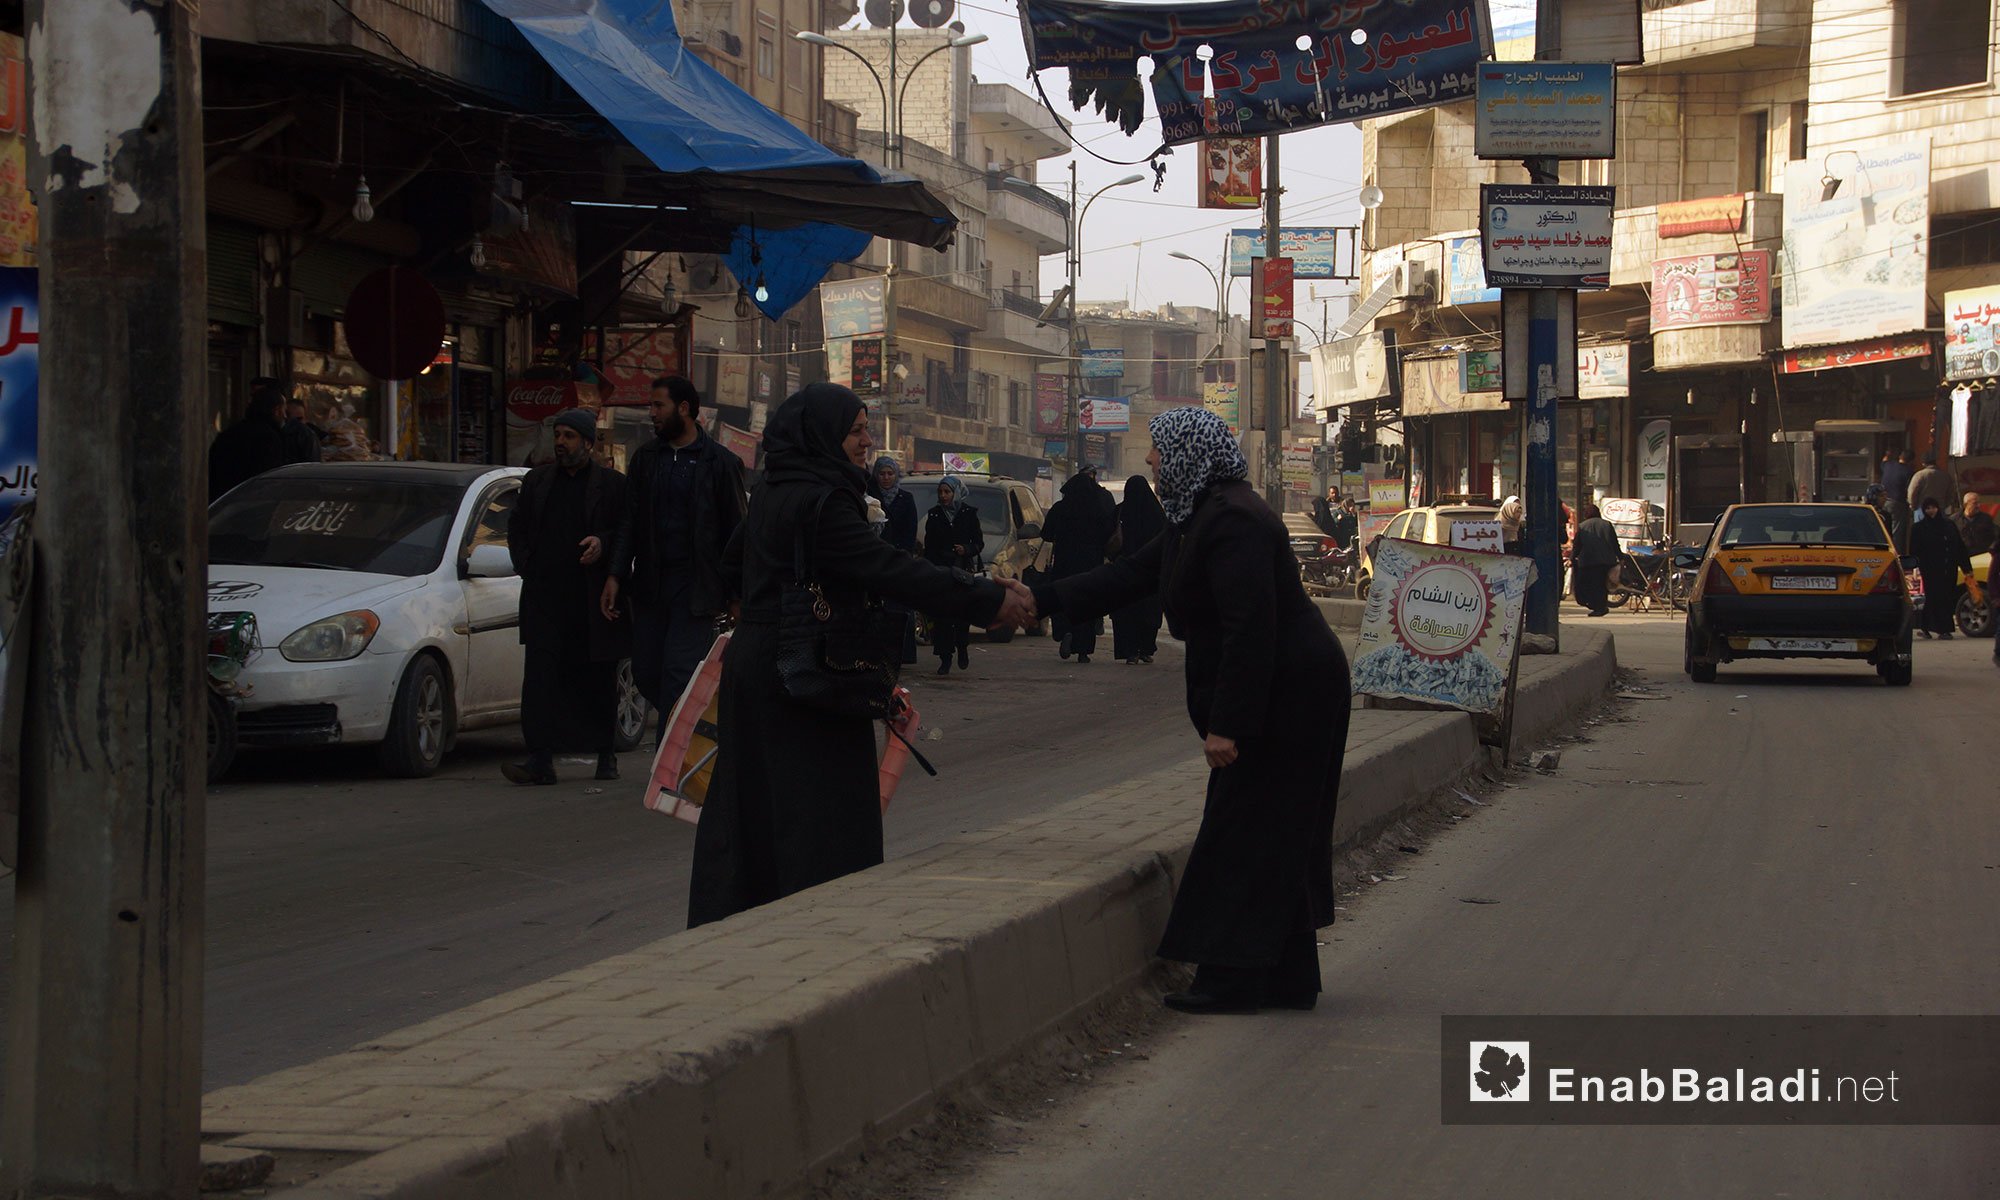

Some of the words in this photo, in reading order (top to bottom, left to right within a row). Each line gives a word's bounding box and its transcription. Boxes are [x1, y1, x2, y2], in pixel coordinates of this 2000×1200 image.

[1357, 7, 1473, 73] للعبور
[1108, 45, 1134, 60] لسنا
[1295, 33, 1348, 85] إلى
[1393, 72, 1437, 101] رحلات
[1440, 71, 1476, 92] يوجد
[1504, 71, 1542, 85] الجراح
[1544, 71, 1584, 86] الطبيب
[1306, 88, 1334, 120] إلى
[1337, 86, 1390, 114] يومية
[1486, 89, 1518, 113] علي
[1522, 89, 1563, 109] السيد
[1567, 91, 1603, 105] محمد
[1890, 151, 1923, 166] مطاعم
[1494, 189, 1544, 203] التجميلية
[1544, 190, 1579, 203] السنية
[1536, 210, 1578, 228] الدكتور
[1492, 233, 1525, 250] عيسى
[1527, 233, 1551, 250] سيد
[1552, 231, 1582, 249] خالد
[1584, 233, 1612, 249] محمد
[1535, 256, 1558, 268] الأسنان
[1558, 256, 1570, 268] طب
[1491, 275, 1520, 285] 238894
[1578, 350, 1599, 376] زي
[1603, 350, 1624, 360] شركة
[1214, 385, 1238, 395] مركز
[1377, 491, 1397, 502] ١٨٠٠
[1461, 527, 1498, 544] مخبز
[1407, 585, 1452, 606] الشام
[1454, 592, 1480, 612] زين
[1410, 615, 1469, 640] للصرافة
